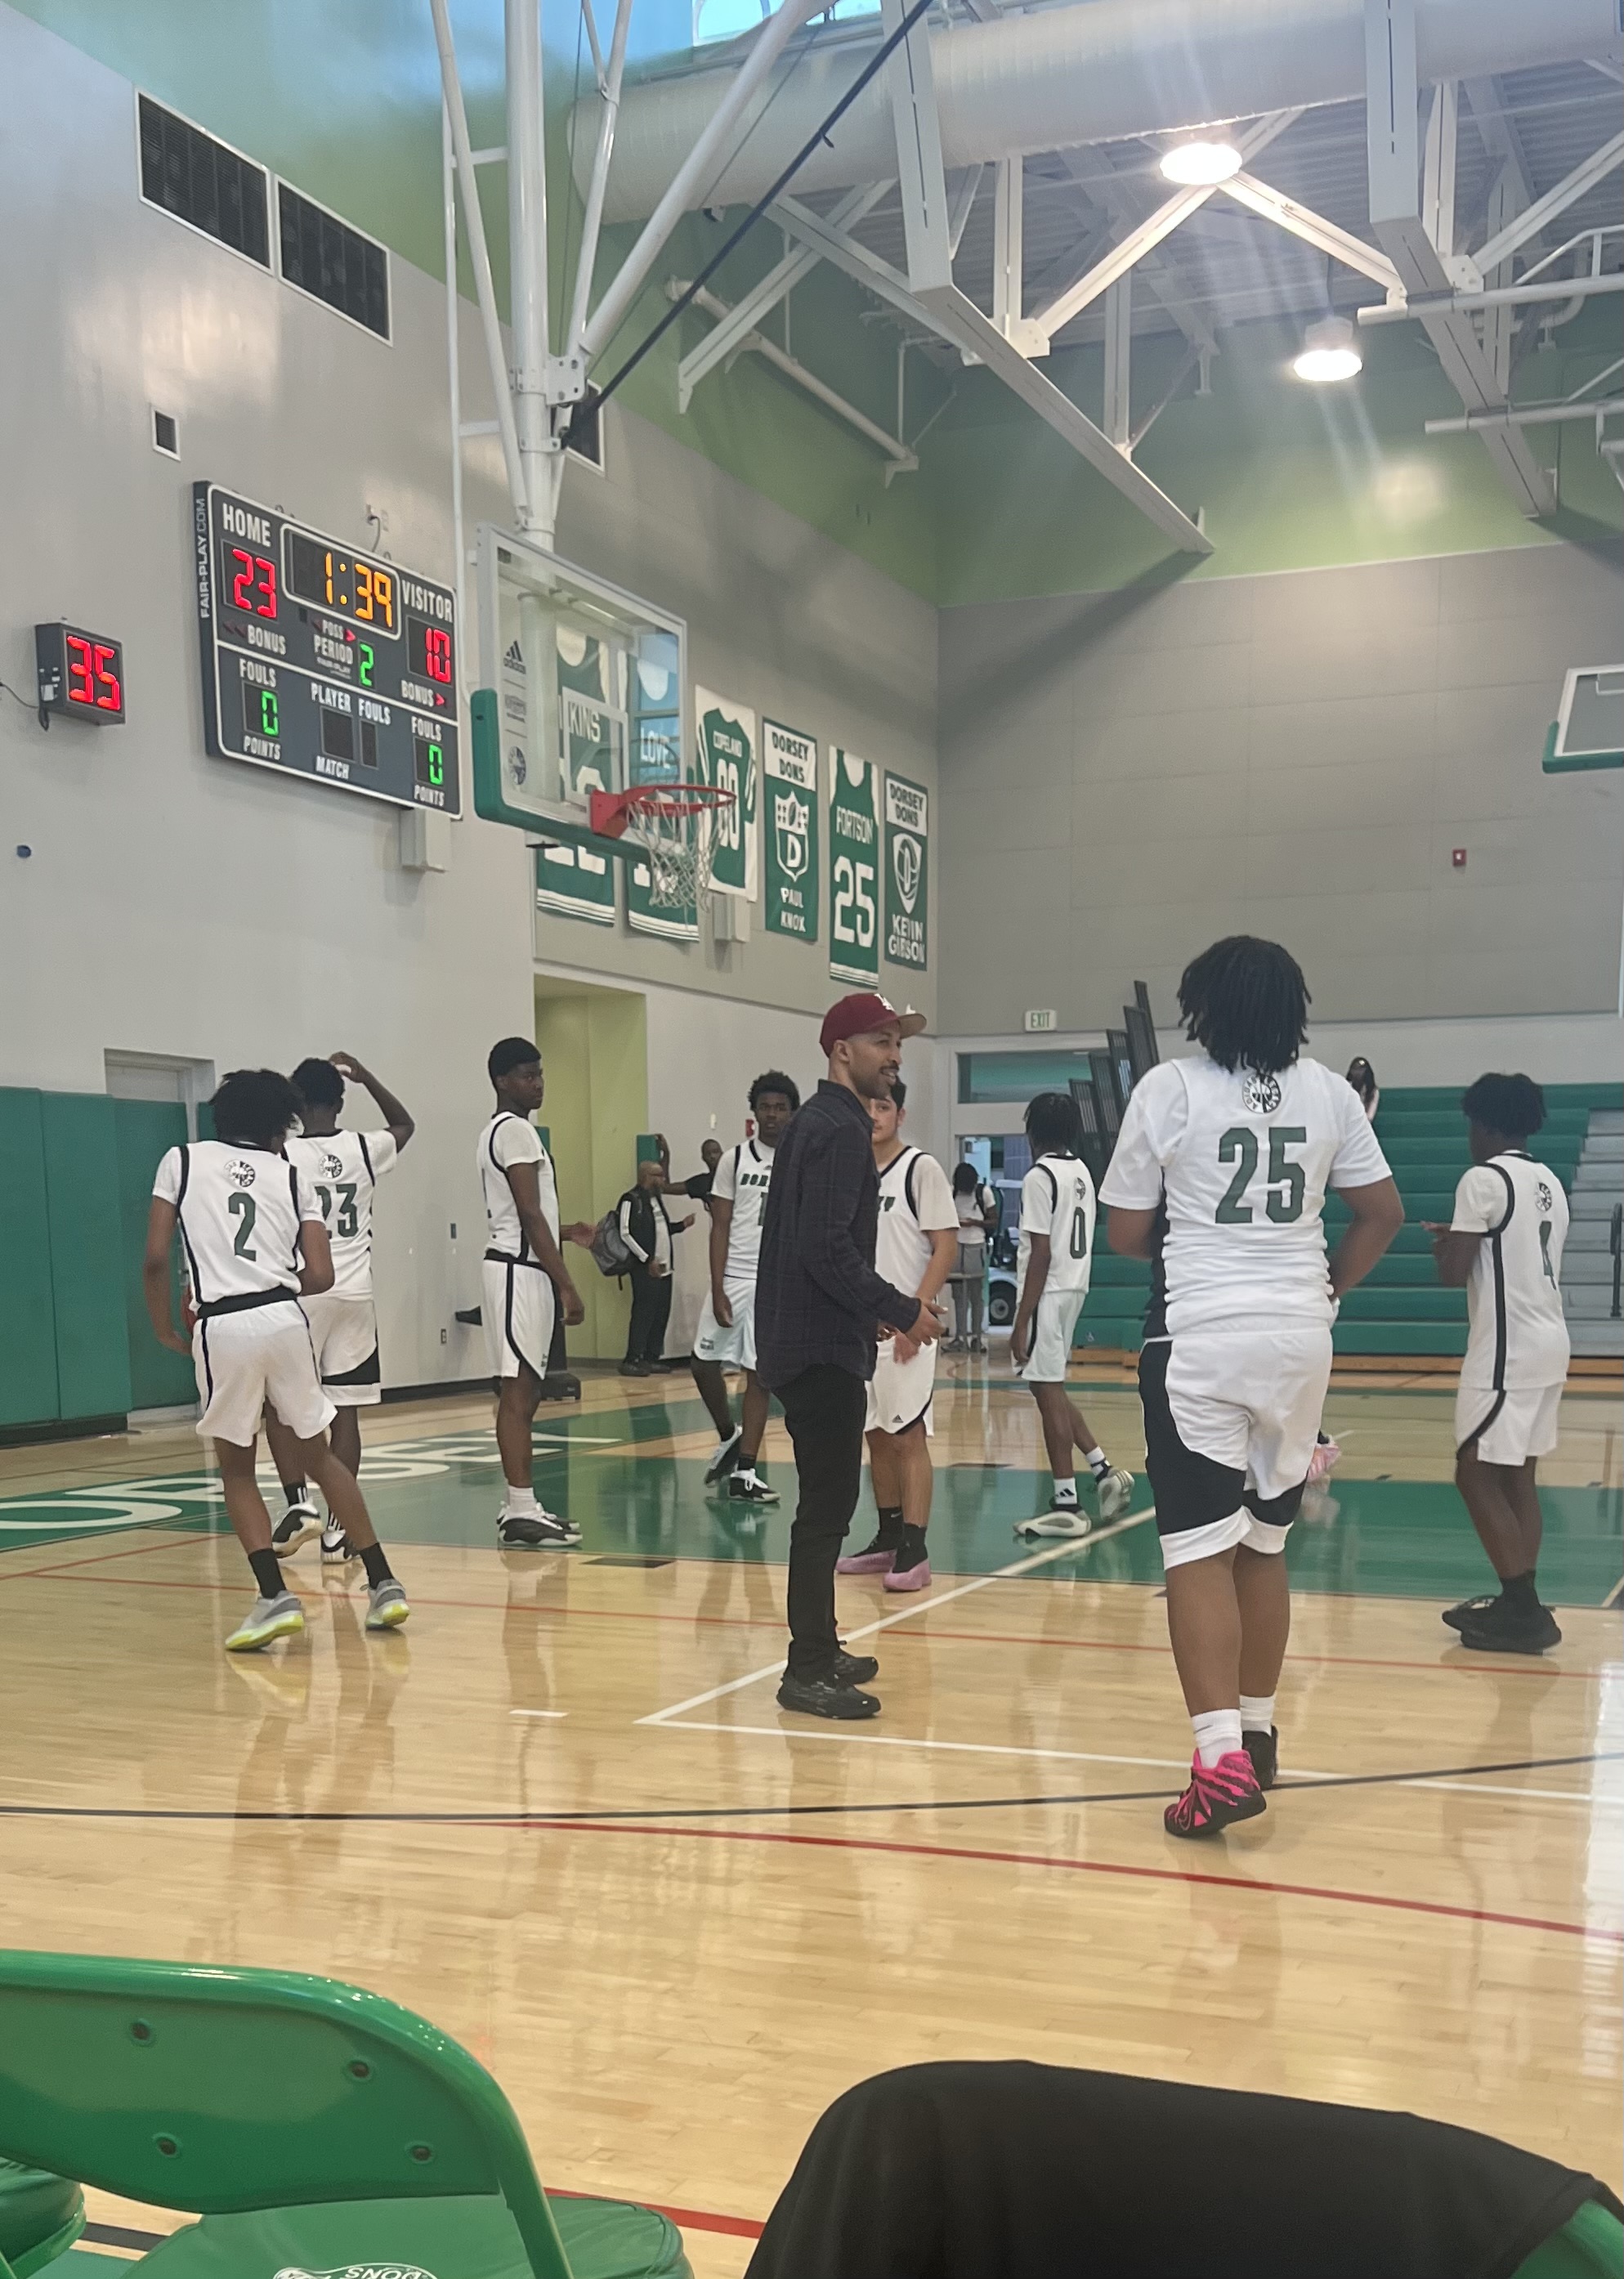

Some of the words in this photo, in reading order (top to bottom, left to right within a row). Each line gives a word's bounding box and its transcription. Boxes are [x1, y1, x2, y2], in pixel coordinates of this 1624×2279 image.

[222, 503, 271, 548] HOME
[232, 548, 277, 619] 23
[325, 552, 392, 628] 1:39
[401, 580, 453, 623] VISITOR
[247, 625, 286, 655] BONUS
[314, 634, 353, 665] PERIOD
[425, 627, 450, 683] 10
[67, 635, 121, 711] 35
[239, 658, 276, 688] FOULS
[360, 643, 374, 687] 2
[261, 690, 279, 736] 0
[311, 682, 351, 714] PLAYER
[358, 697, 391, 726] FOULS
[400, 680, 434, 707] BONUS
[244, 735, 281, 761] POINTS
[411, 716, 441, 742] FOULS
[772, 732, 808, 761] DORSEY
[315, 755, 350, 780] MATCH
[428, 744, 443, 785] 0
[779, 758, 805, 783] DONS
[414, 784, 445, 807] POINTS
[889, 782, 923, 812] DORSEY
[836, 805, 873, 844] FORTSON
[834, 855, 875, 947] 25
[781, 911, 807, 932] KNOX
[1031, 1012, 1050, 1028] EXIT
[1215, 1126, 1307, 1224] 25
[228, 1192, 256, 1261] 2
[1070, 1207, 1087, 1259] 0
